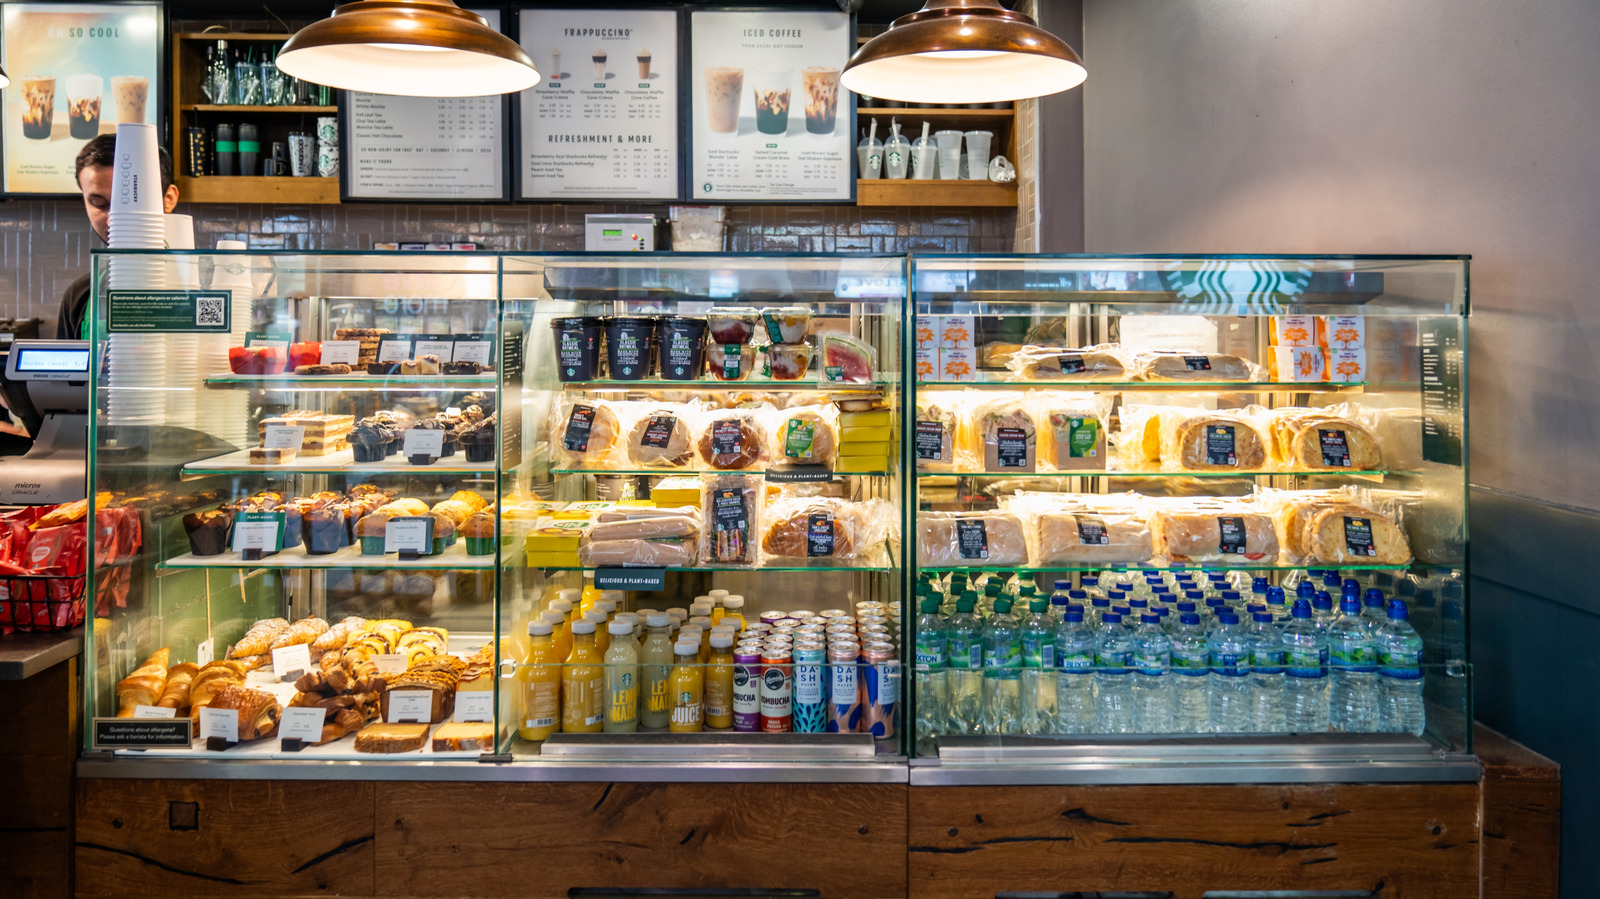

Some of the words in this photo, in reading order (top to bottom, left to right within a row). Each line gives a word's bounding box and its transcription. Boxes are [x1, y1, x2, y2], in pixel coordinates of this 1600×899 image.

[48, 28, 63, 38] OH
[69, 28, 83, 38] SO
[89, 28, 119, 38] COOL
[743, 29, 764, 37] ICED
[769, 29, 802, 37] COFFEE
[548, 135, 613, 143] REFRESHMENT
[618, 135, 623, 143] &
[628, 135, 652, 143] MORE
[671, 706, 700, 723] JUICE
